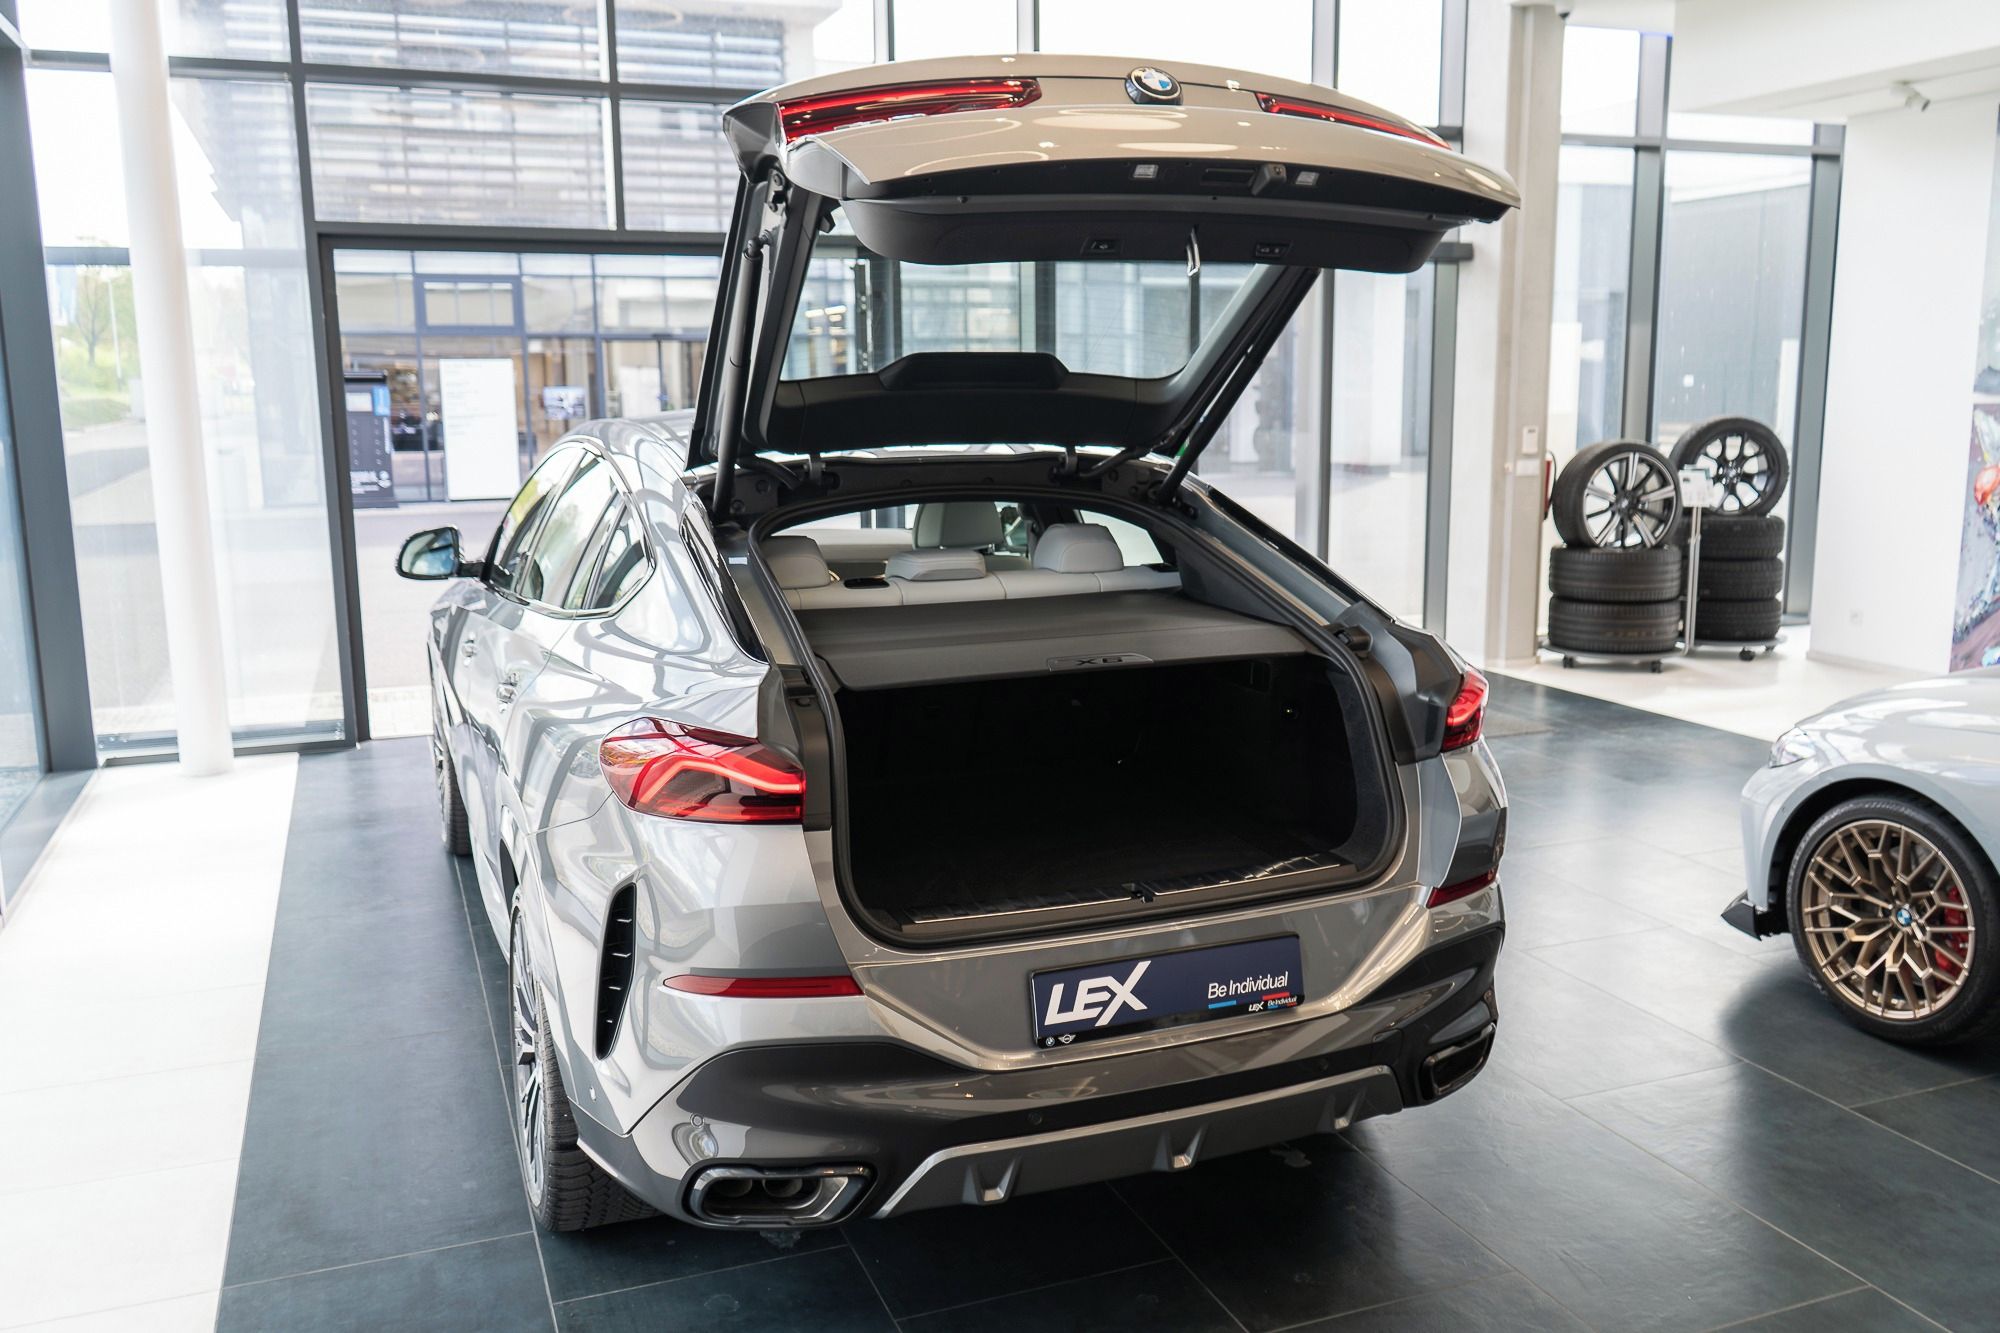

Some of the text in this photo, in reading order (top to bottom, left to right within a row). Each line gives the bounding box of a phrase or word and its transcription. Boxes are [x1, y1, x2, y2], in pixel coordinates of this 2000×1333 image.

[1044, 960, 1152, 1027] LEX
[1208, 971, 1289, 999] Be Individual
[1248, 1001, 1264, 1012] LEX
